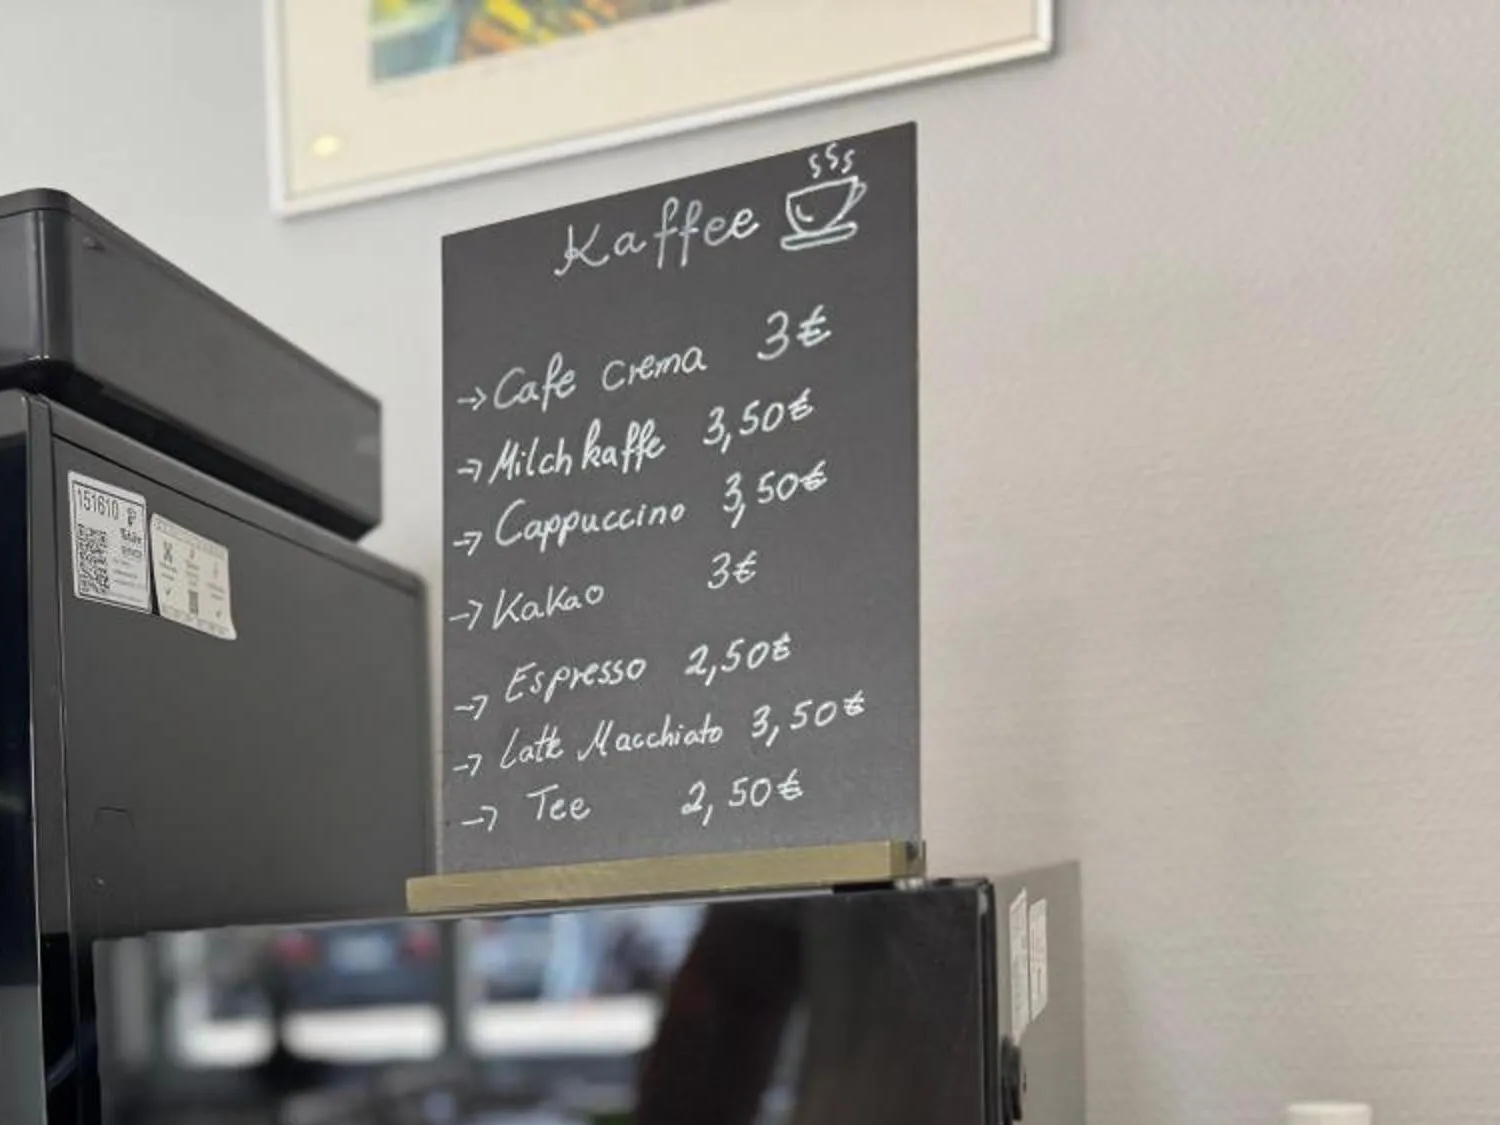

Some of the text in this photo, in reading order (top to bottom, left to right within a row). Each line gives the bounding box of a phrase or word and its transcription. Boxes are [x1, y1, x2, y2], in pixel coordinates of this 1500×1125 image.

[554, 197, 760, 276] Kaffee
[703, 387, 815, 454] 3,50€
[494, 460, 828, 553] Cappuccino 3,50€
[707, 550, 758, 590] 3€
[505, 632, 792, 704] Espresso 2,50€
[577, 712, 724, 761] Macchiato
[751, 689, 865, 748] 3,50€
[525, 784, 591, 822] Tee
